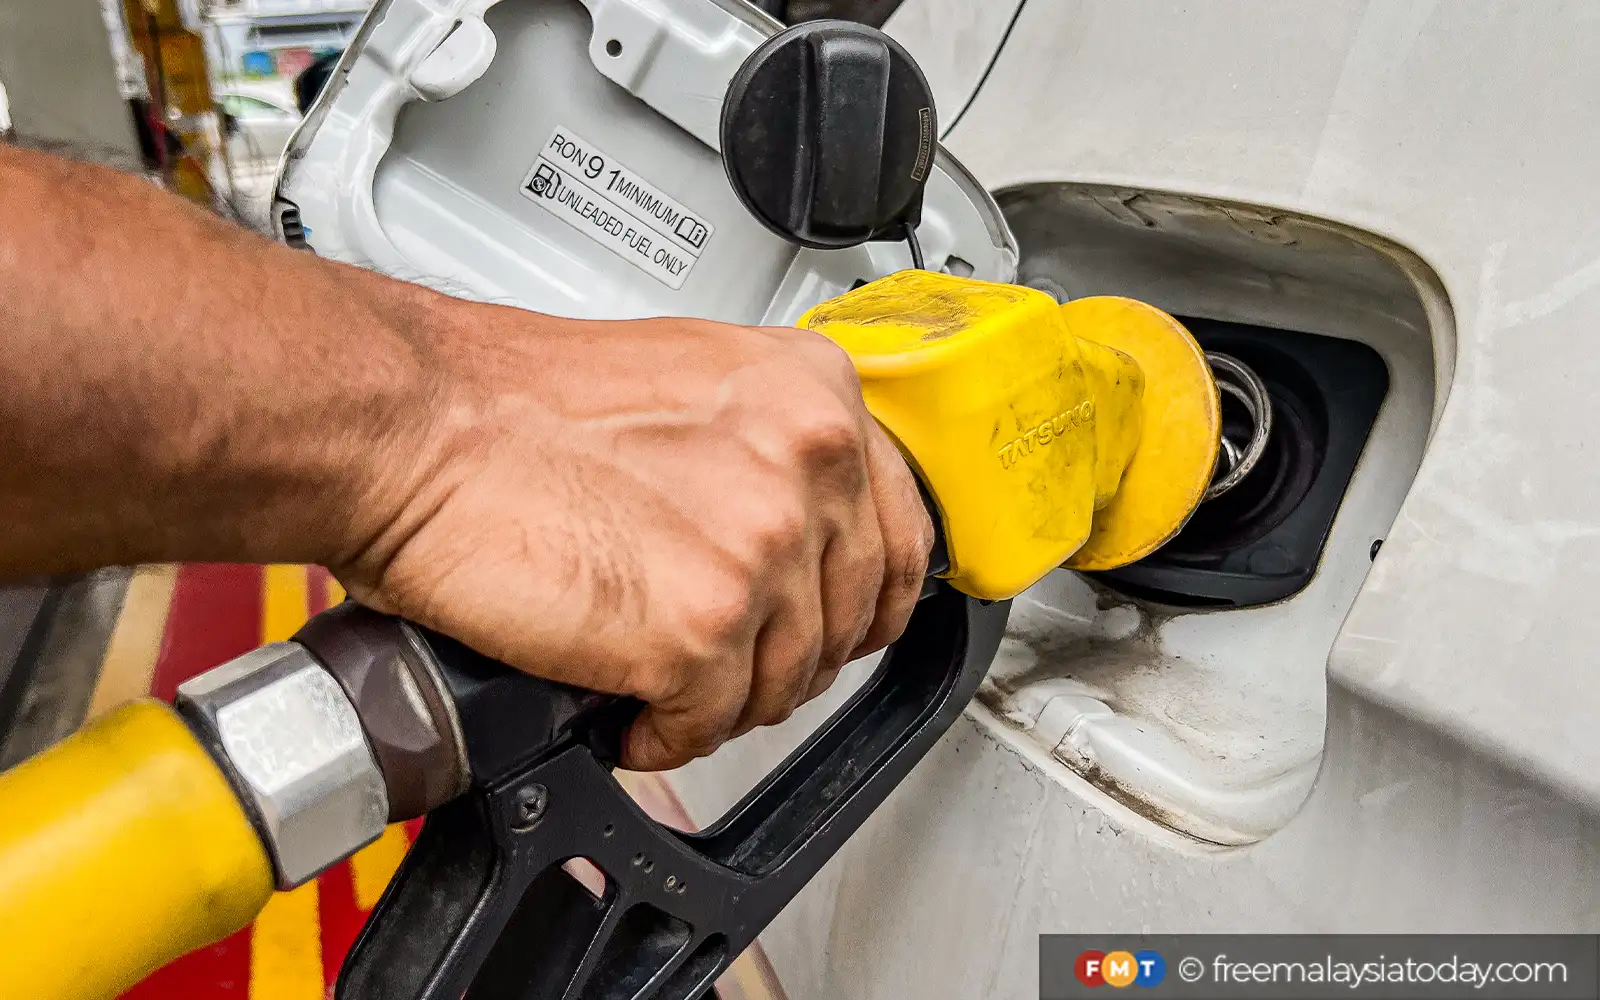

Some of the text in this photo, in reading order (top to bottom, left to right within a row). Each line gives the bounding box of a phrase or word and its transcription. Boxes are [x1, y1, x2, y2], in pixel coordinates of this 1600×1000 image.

[550, 134, 588, 167] RON
[615, 177, 680, 226] MINIMUM
[558, 186, 687, 276] UNLEADED FUEL ONLY
[997, 400, 1093, 469] TATSUNO
